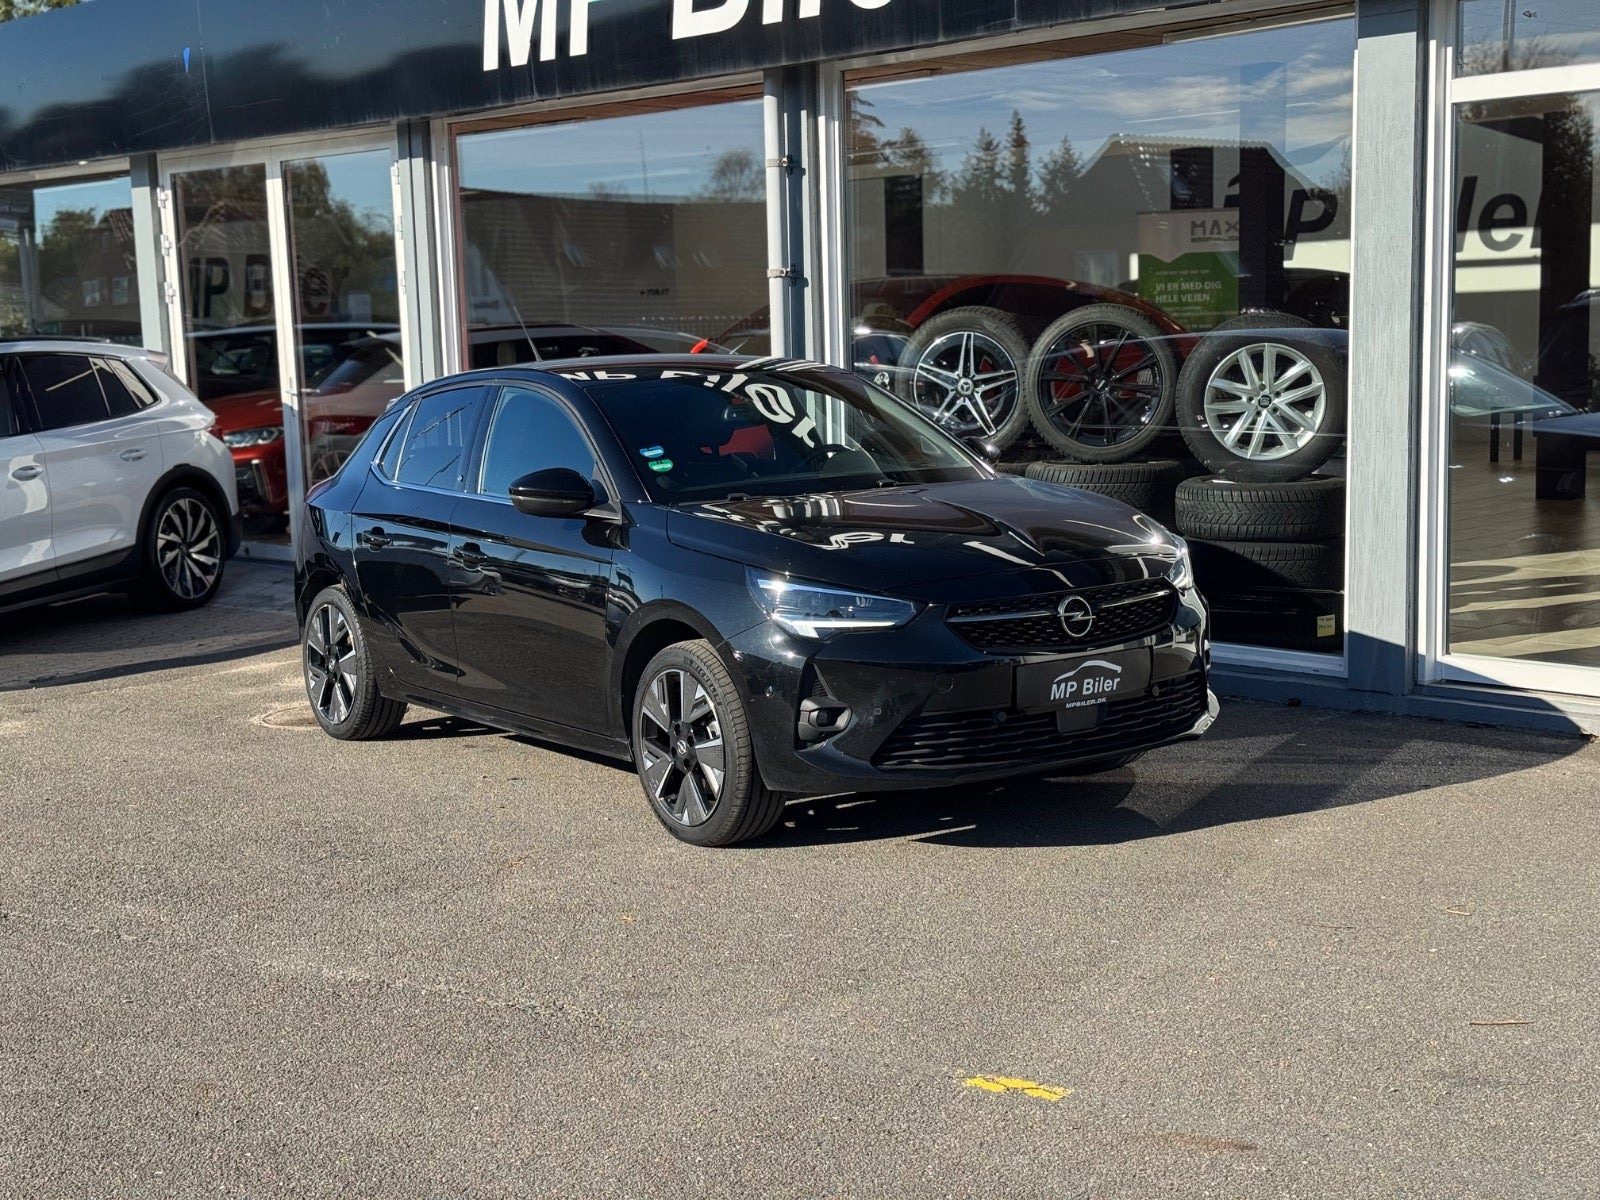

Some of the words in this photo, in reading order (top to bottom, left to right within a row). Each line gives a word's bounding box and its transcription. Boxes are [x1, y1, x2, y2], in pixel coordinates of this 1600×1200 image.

[1155, 283, 1165, 291] VI
[1167, 282, 1179, 291] ER
[1180, 282, 1202, 290] MED
[1204, 281, 1222, 290] DIG
[1155, 294, 1179, 303] HELE
[1181, 293, 1210, 303] VEJEN
[1050, 681, 1078, 700] MP
[1082, 677, 1120, 695] Biler
[1065, 697, 1107, 709] MPBILER.DK
